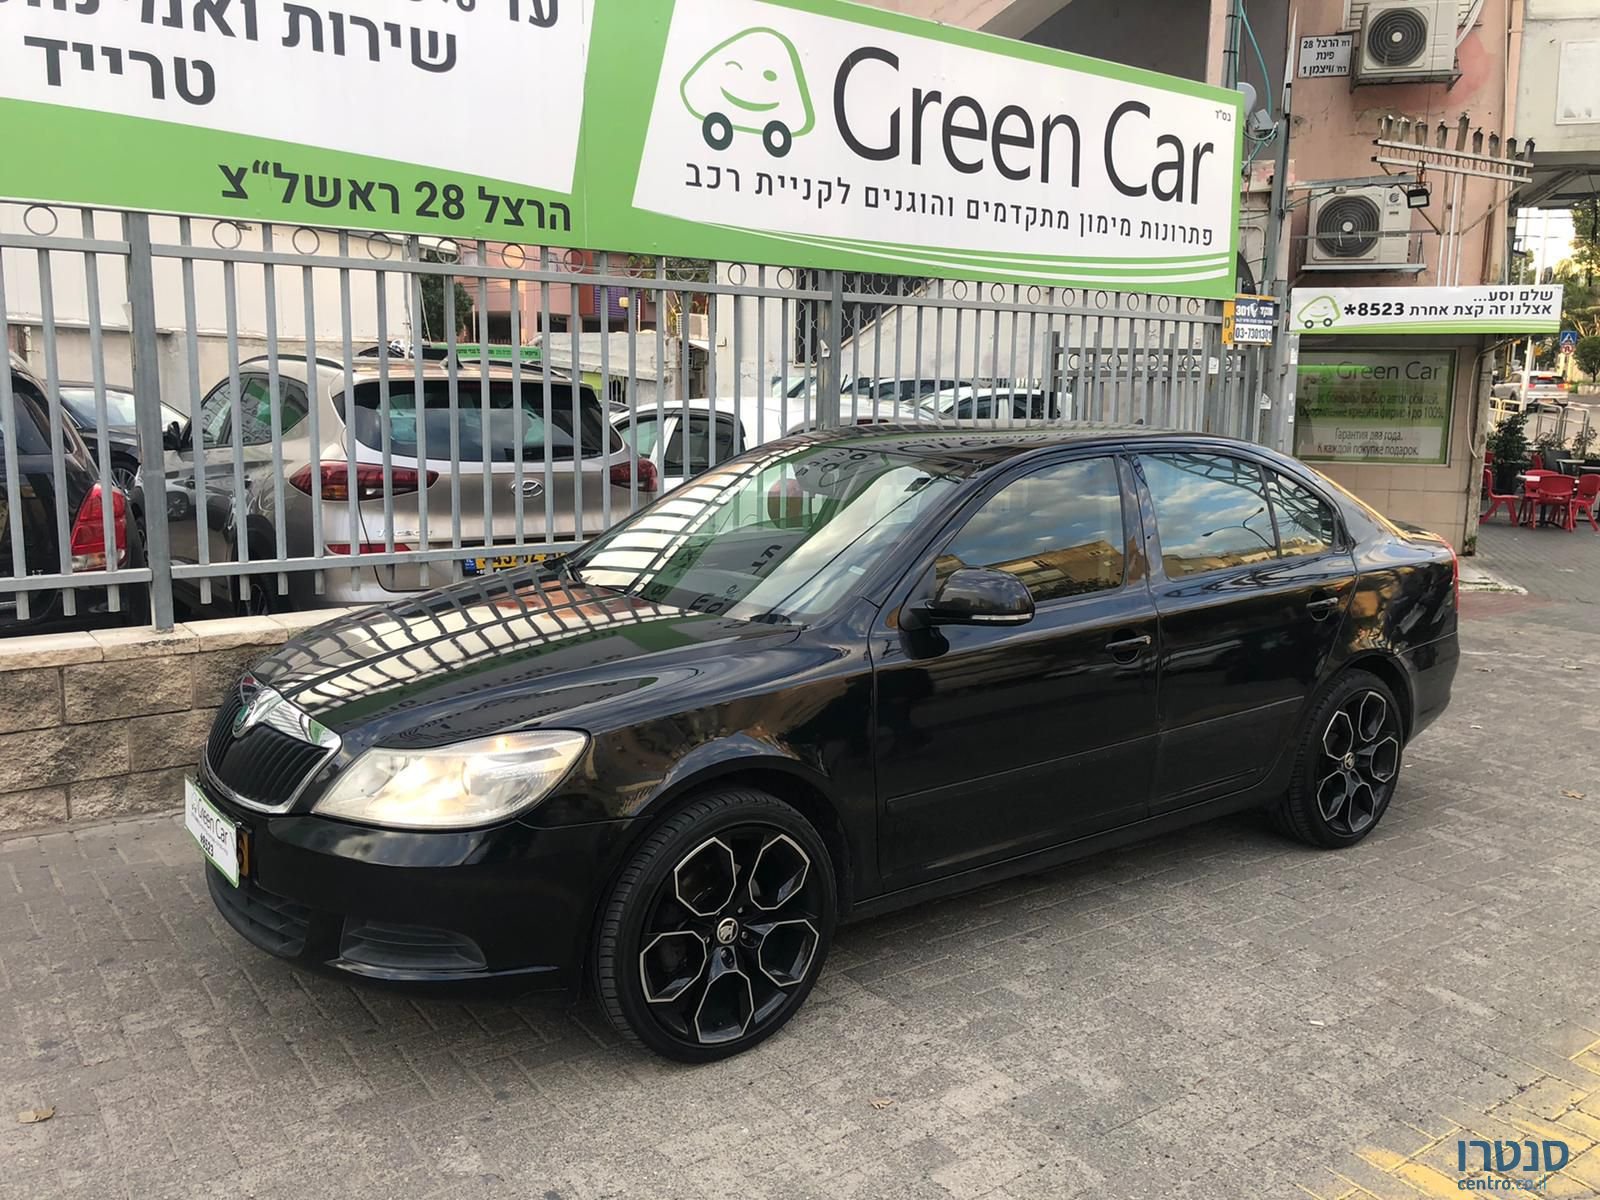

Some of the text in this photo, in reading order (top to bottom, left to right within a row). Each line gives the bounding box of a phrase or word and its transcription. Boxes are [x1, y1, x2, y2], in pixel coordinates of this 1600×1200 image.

[282, 2, 457, 73] שירות
[1316, 38, 1339, 48] הרצל
[1303, 40, 1314, 49] 28
[1315, 51, 1335, 60] פינת
[24, 35, 215, 105] טרייד
[1303, 66, 1307, 74] 1
[1309, 65, 1335, 76] וויצמן
[833, 46, 1214, 205] Green Car
[414, 181, 466, 221] 28
[685, 162, 1213, 246] פתרונות מימון מתקדמים והוגנים לקניית רכב
[478, 186, 571, 231] הרצל
[1520, 288, 1553, 301] שלם
[1409, 304, 1449, 316] אחרת
[1452, 304, 1484, 318] קצת
[1489, 304, 1506, 315] זה
[1510, 303, 1552, 315] אצלנו
[1336, 361, 1441, 380] Green Car
[1335, 427, 1369, 441] Гарантия
[1369, 431, 1385, 441] два
[1353, 445, 1386, 458] покупке
[215, 818, 228, 846] Car
